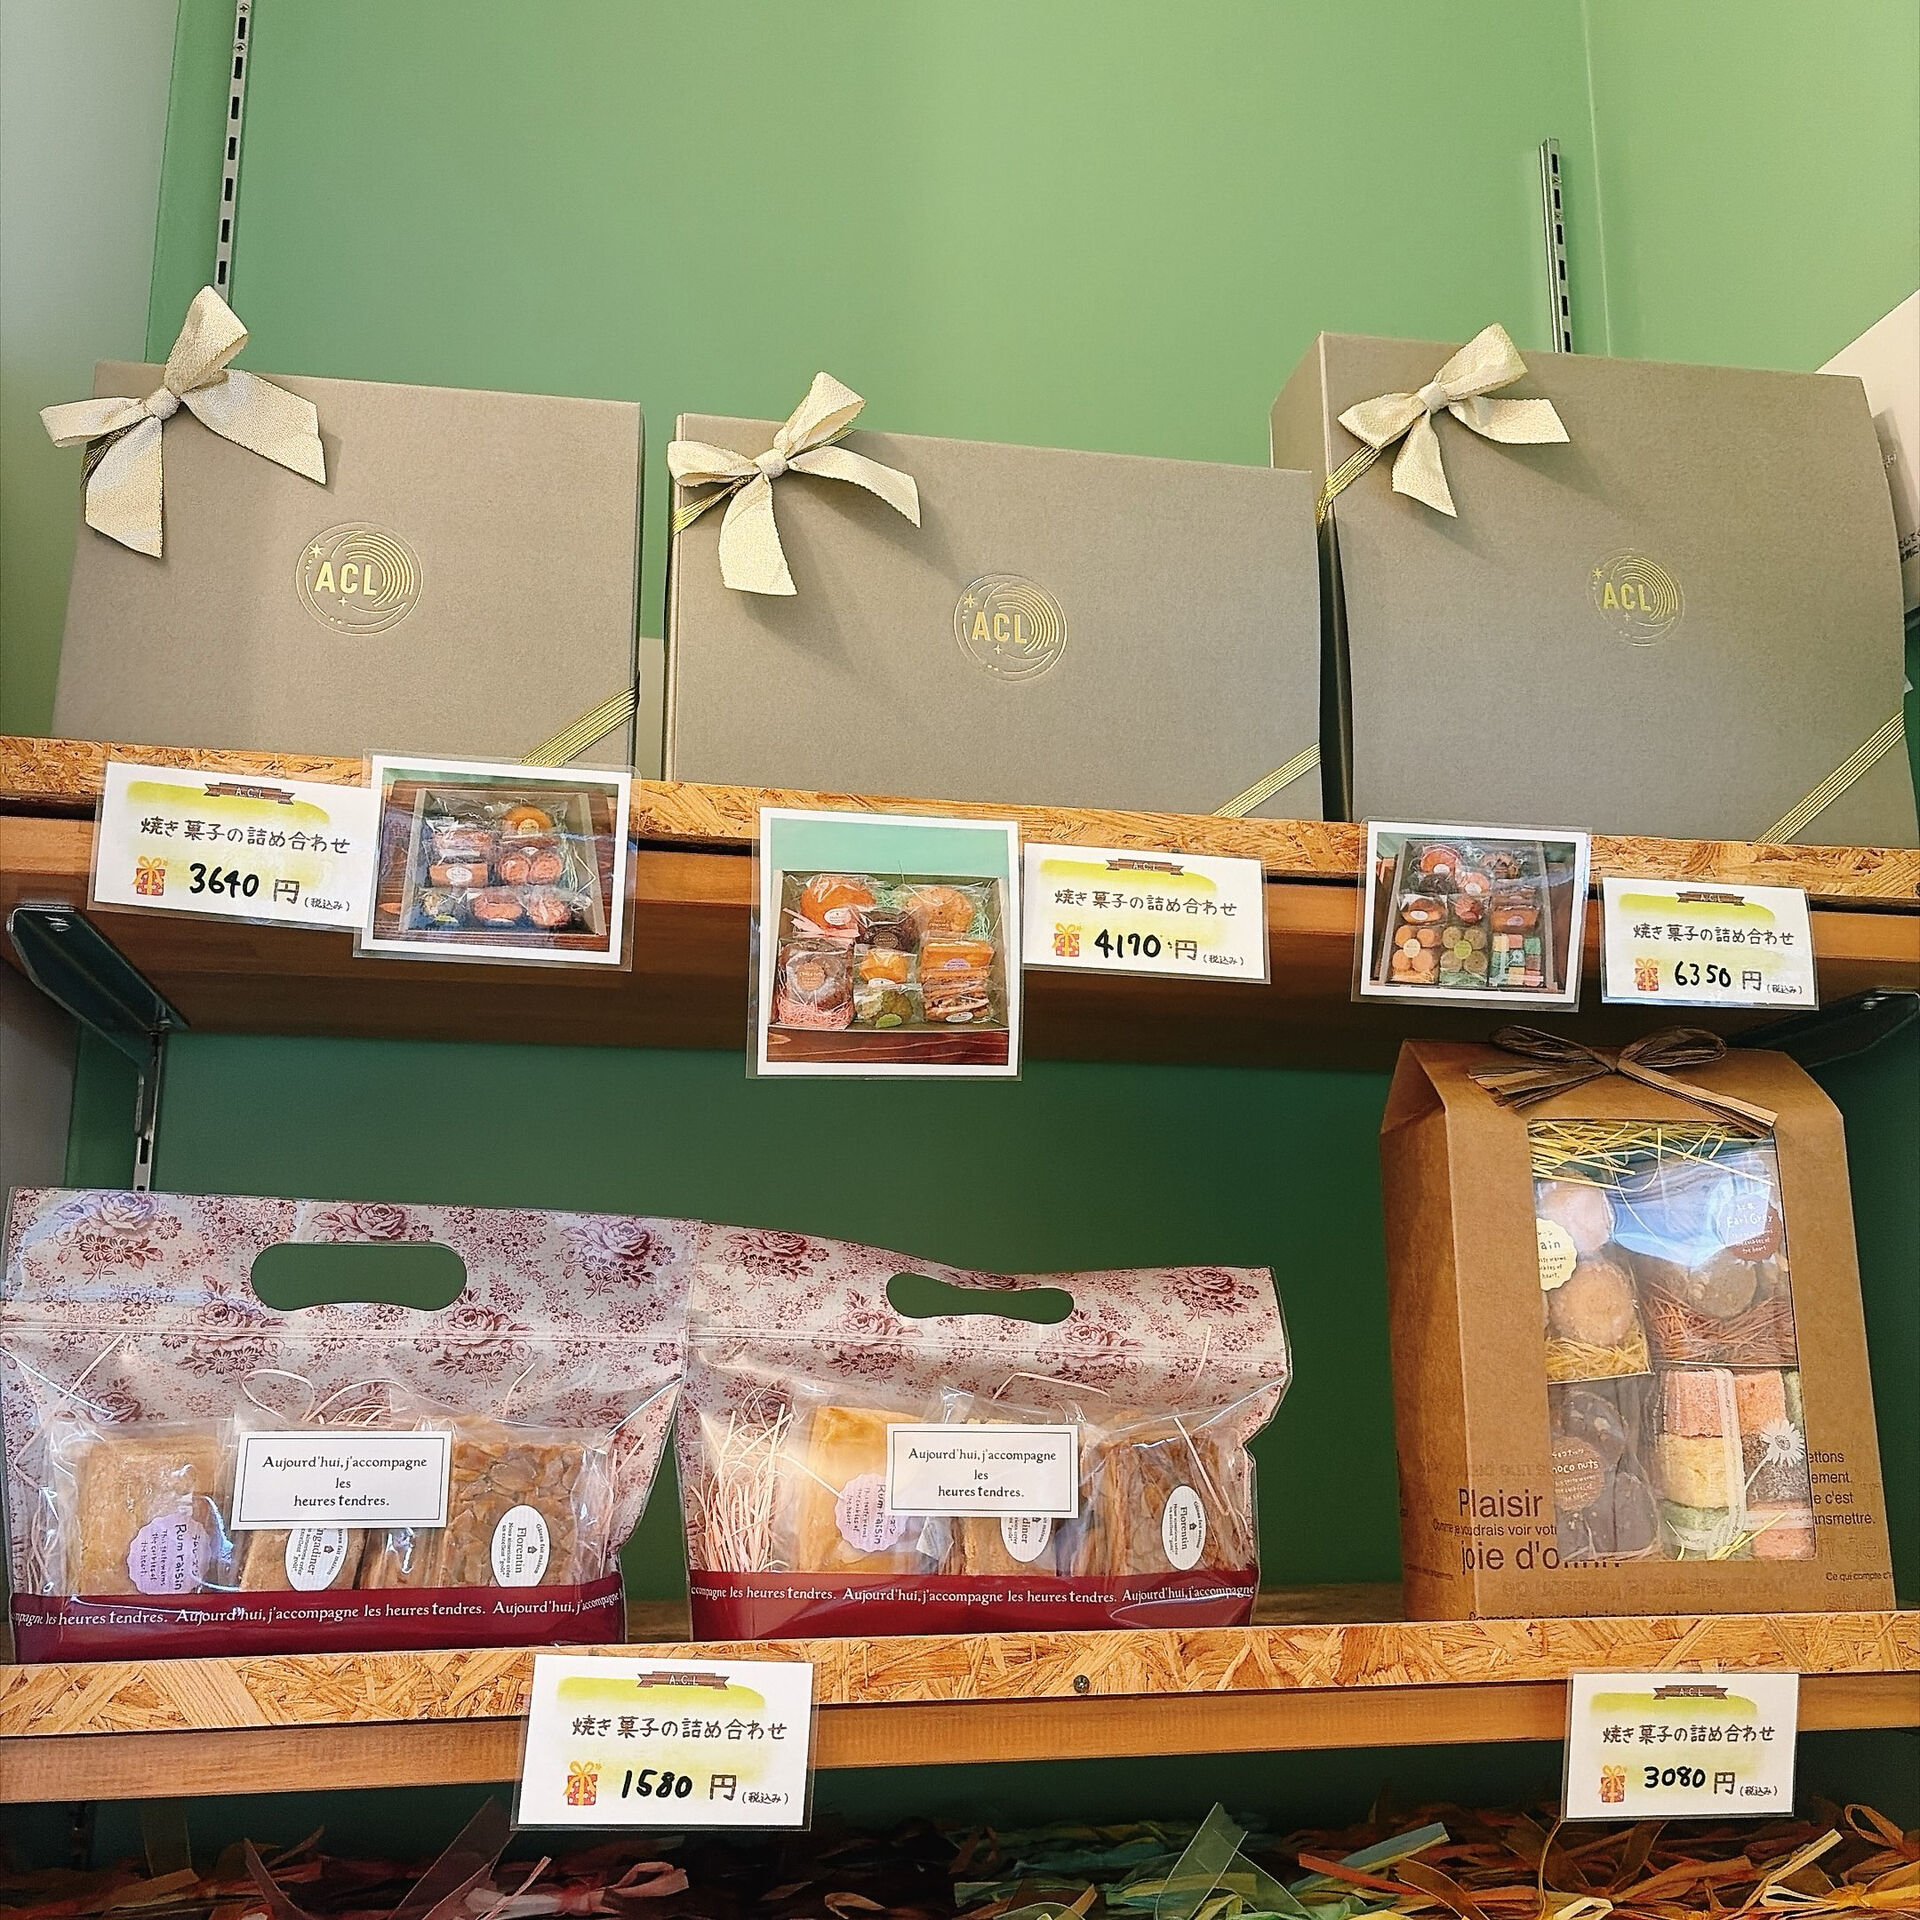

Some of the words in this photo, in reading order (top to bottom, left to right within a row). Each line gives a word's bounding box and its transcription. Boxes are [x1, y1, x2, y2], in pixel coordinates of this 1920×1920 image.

[314, 561, 377, 596] ACL
[1602, 582, 1652, 611] ACL
[971, 611, 1027, 644] ACL
[141, 816, 351, 854] 焼き菓子の詰め合わせ
[189, 863, 259, 897] 3640
[274, 879, 299, 904] 円
[1055, 889, 1237, 916] 焼き菓子の詰め合わせ
[1094, 929, 1161, 958] 4170
[1174, 939, 1198, 961] 円
[1633, 923, 1794, 946] 焼き菓子の詰め合わせ
[1674, 960, 1731, 987] 6350
[1742, 971, 1761, 990] 円
[974, 1469, 989, 1480] les
[1577, 1459, 1599, 1471] nuts
[335, 1477, 351, 1489] les
[876, 1484, 886, 1508] Rum
[938, 1486, 976, 1497] heures
[978, 1486, 1024, 1498] tendres.
[294, 1495, 336, 1507] heures
[338, 1495, 390, 1507] tendres.
[1458, 1488, 1543, 1518] Plaisir
[1825, 1492, 1854, 1504] c'est
[174, 1524, 187, 1552] Rum
[874, 1511, 884, 1544] raisin
[1180, 1506, 1189, 1550] Florentin
[1507, 1525, 1530, 1536] voir
[307, 1529, 324, 1576] ngadiner
[515, 1527, 527, 1574] Florentin
[1461, 1540, 1504, 1576] joie
[174, 1554, 184, 1590] raisin
[1826, 1571, 1838, 1581] Ce
[729, 1585, 743, 1598] les
[746, 1586, 785, 1599] heures
[787, 1586, 836, 1600] tendres.
[1007, 1591, 1024, 1602] les
[1027, 1592, 1067, 1603] heures
[1069, 1591, 1117, 1603] tendres.
[45, 1611, 57, 1625] les
[58, 1611, 107, 1626] heures
[108, 1610, 168, 1624] tendres.
[364, 1604, 381, 1617] les
[385, 1603, 429, 1617] heures
[432, 1602, 486, 1616] tendres.
[572, 1714, 787, 1741] 焼き菓子の詰め合わせ
[1602, 1724, 1775, 1744] 焼き菓子の詰め合わせ
[621, 1769, 692, 1799] 1580
[709, 1774, 736, 1801] 円
[1643, 1766, 1706, 1788] 3080
[1713, 1771, 1735, 1795] 円
